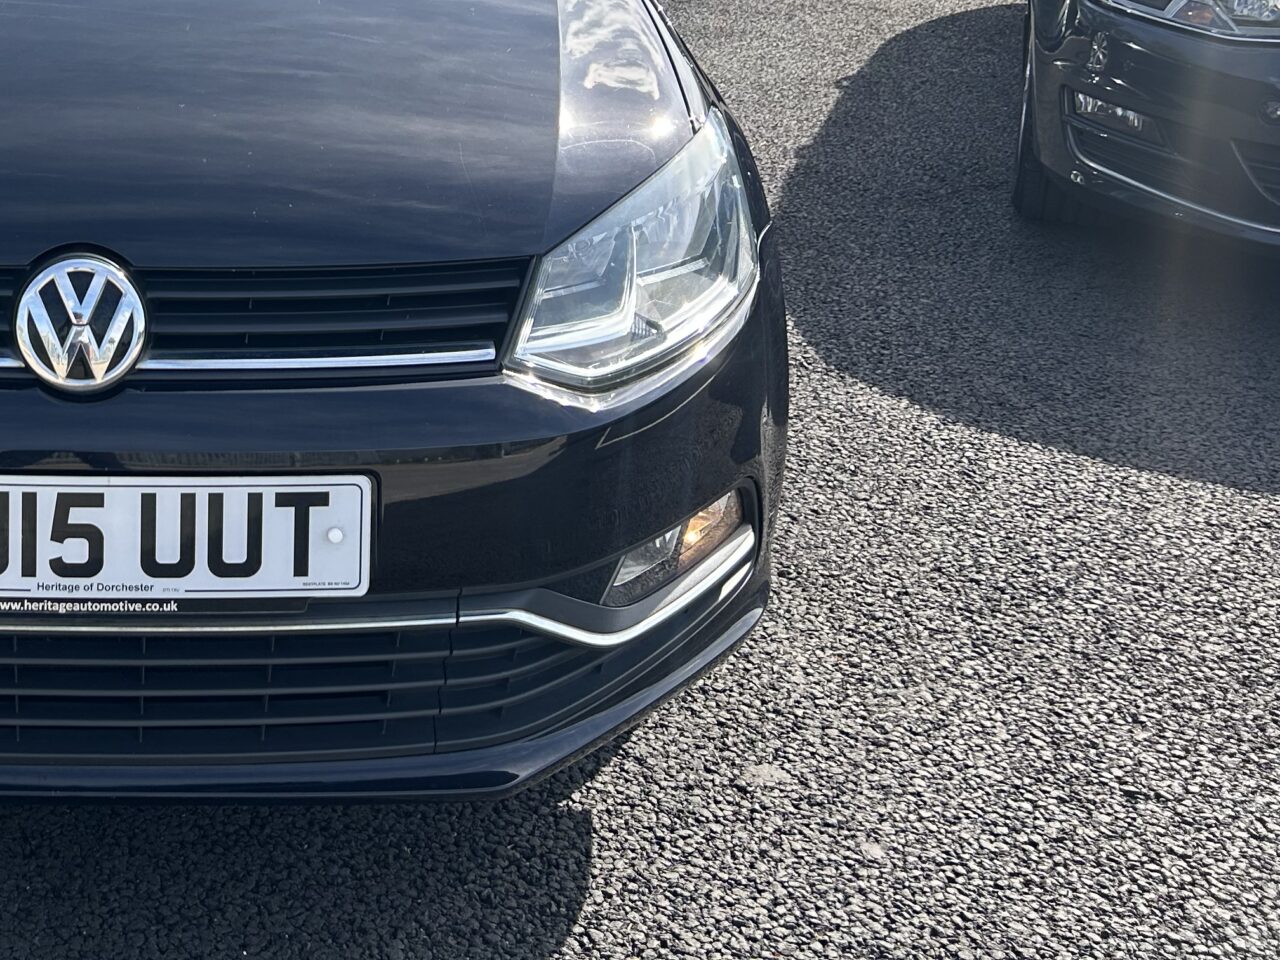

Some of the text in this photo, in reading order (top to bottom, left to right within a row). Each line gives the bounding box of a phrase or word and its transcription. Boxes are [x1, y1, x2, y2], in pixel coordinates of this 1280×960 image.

[140, 492, 330, 579] UUT
[36, 581, 80, 593] Heritage
[83, 582, 94, 592] of
[96, 582, 154, 593] Dorchester
